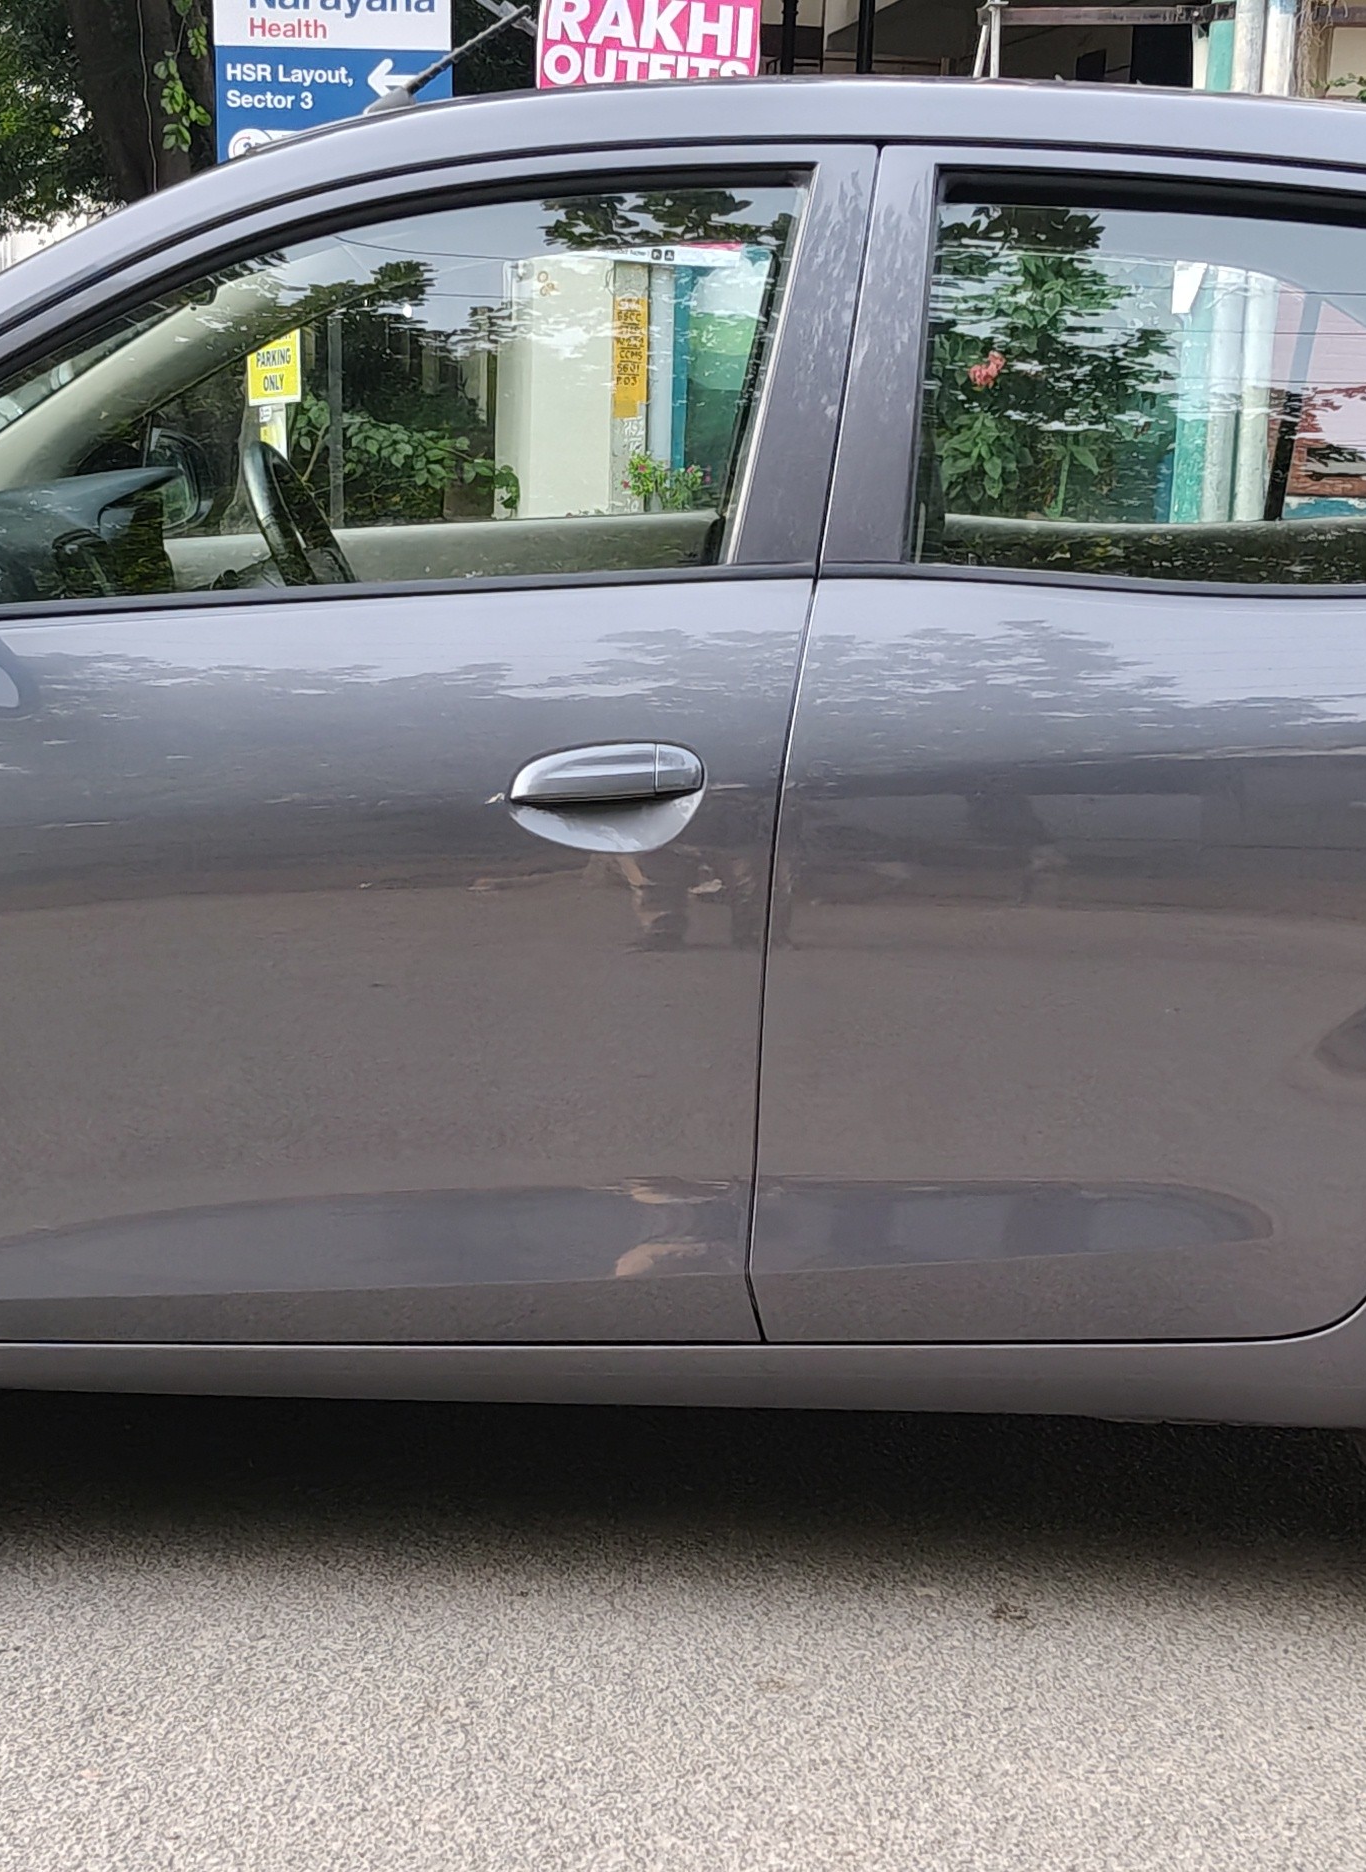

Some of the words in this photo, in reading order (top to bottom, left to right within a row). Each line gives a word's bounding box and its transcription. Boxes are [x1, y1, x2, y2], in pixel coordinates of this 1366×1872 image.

[249, 17, 327, 38] Health
[547, 0, 754, 58] RAKHI
[226, 63, 272, 82] HSR
[278, 64, 354, 88] Layout,
[226, 89, 296, 110] Sector
[300, 91, 314, 110] 3
[256, 347, 292, 368] PARKING
[263, 373, 285, 392] ONLY
